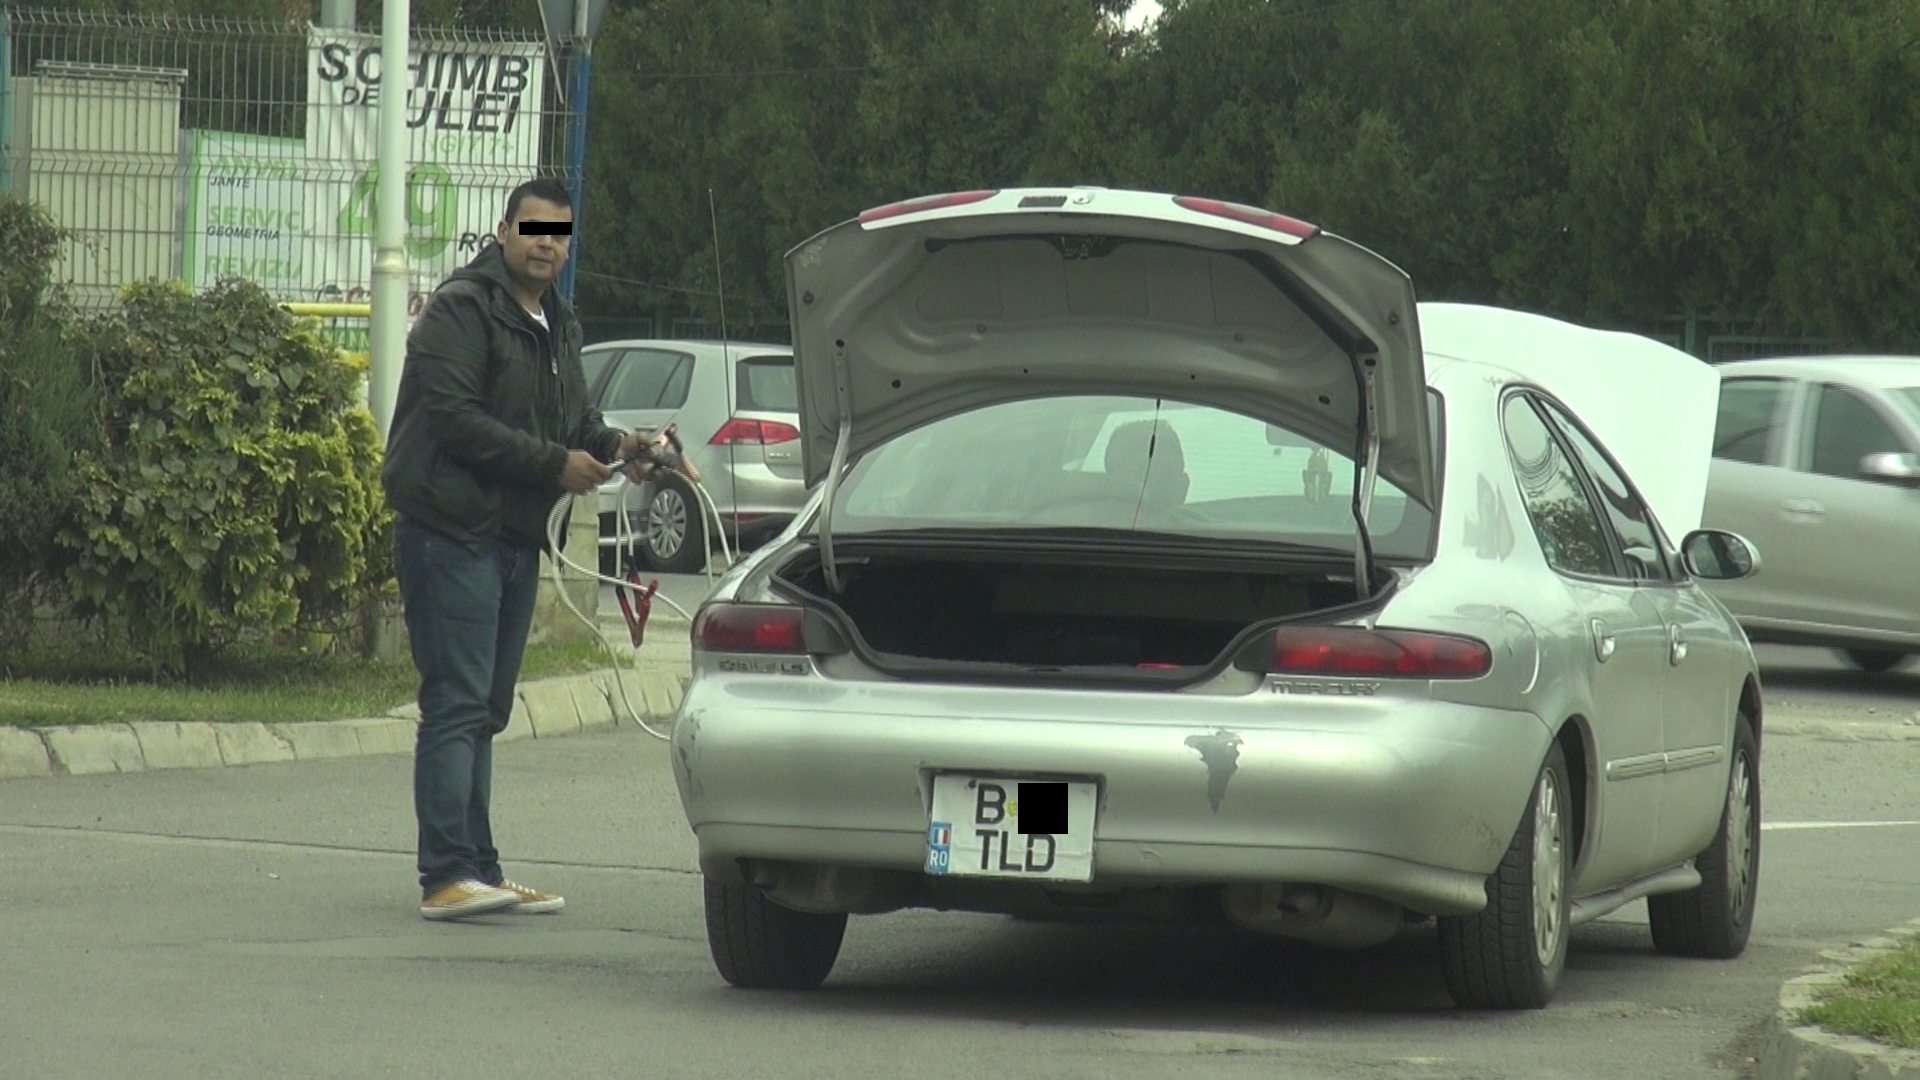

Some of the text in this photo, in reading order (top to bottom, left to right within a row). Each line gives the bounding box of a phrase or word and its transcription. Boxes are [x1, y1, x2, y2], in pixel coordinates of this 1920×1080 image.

[318, 43, 530, 93] SCHIMB
[210, 176, 250, 189] JANTE
[337, 160, 457, 260] 49
[206, 225, 281, 241] GEOMETRIA
[1271, 680, 1381, 696] MERCURY
[975, 783, 1006, 824] B
[929, 851, 948, 866] RO
[975, 829, 1056, 872] TLD
